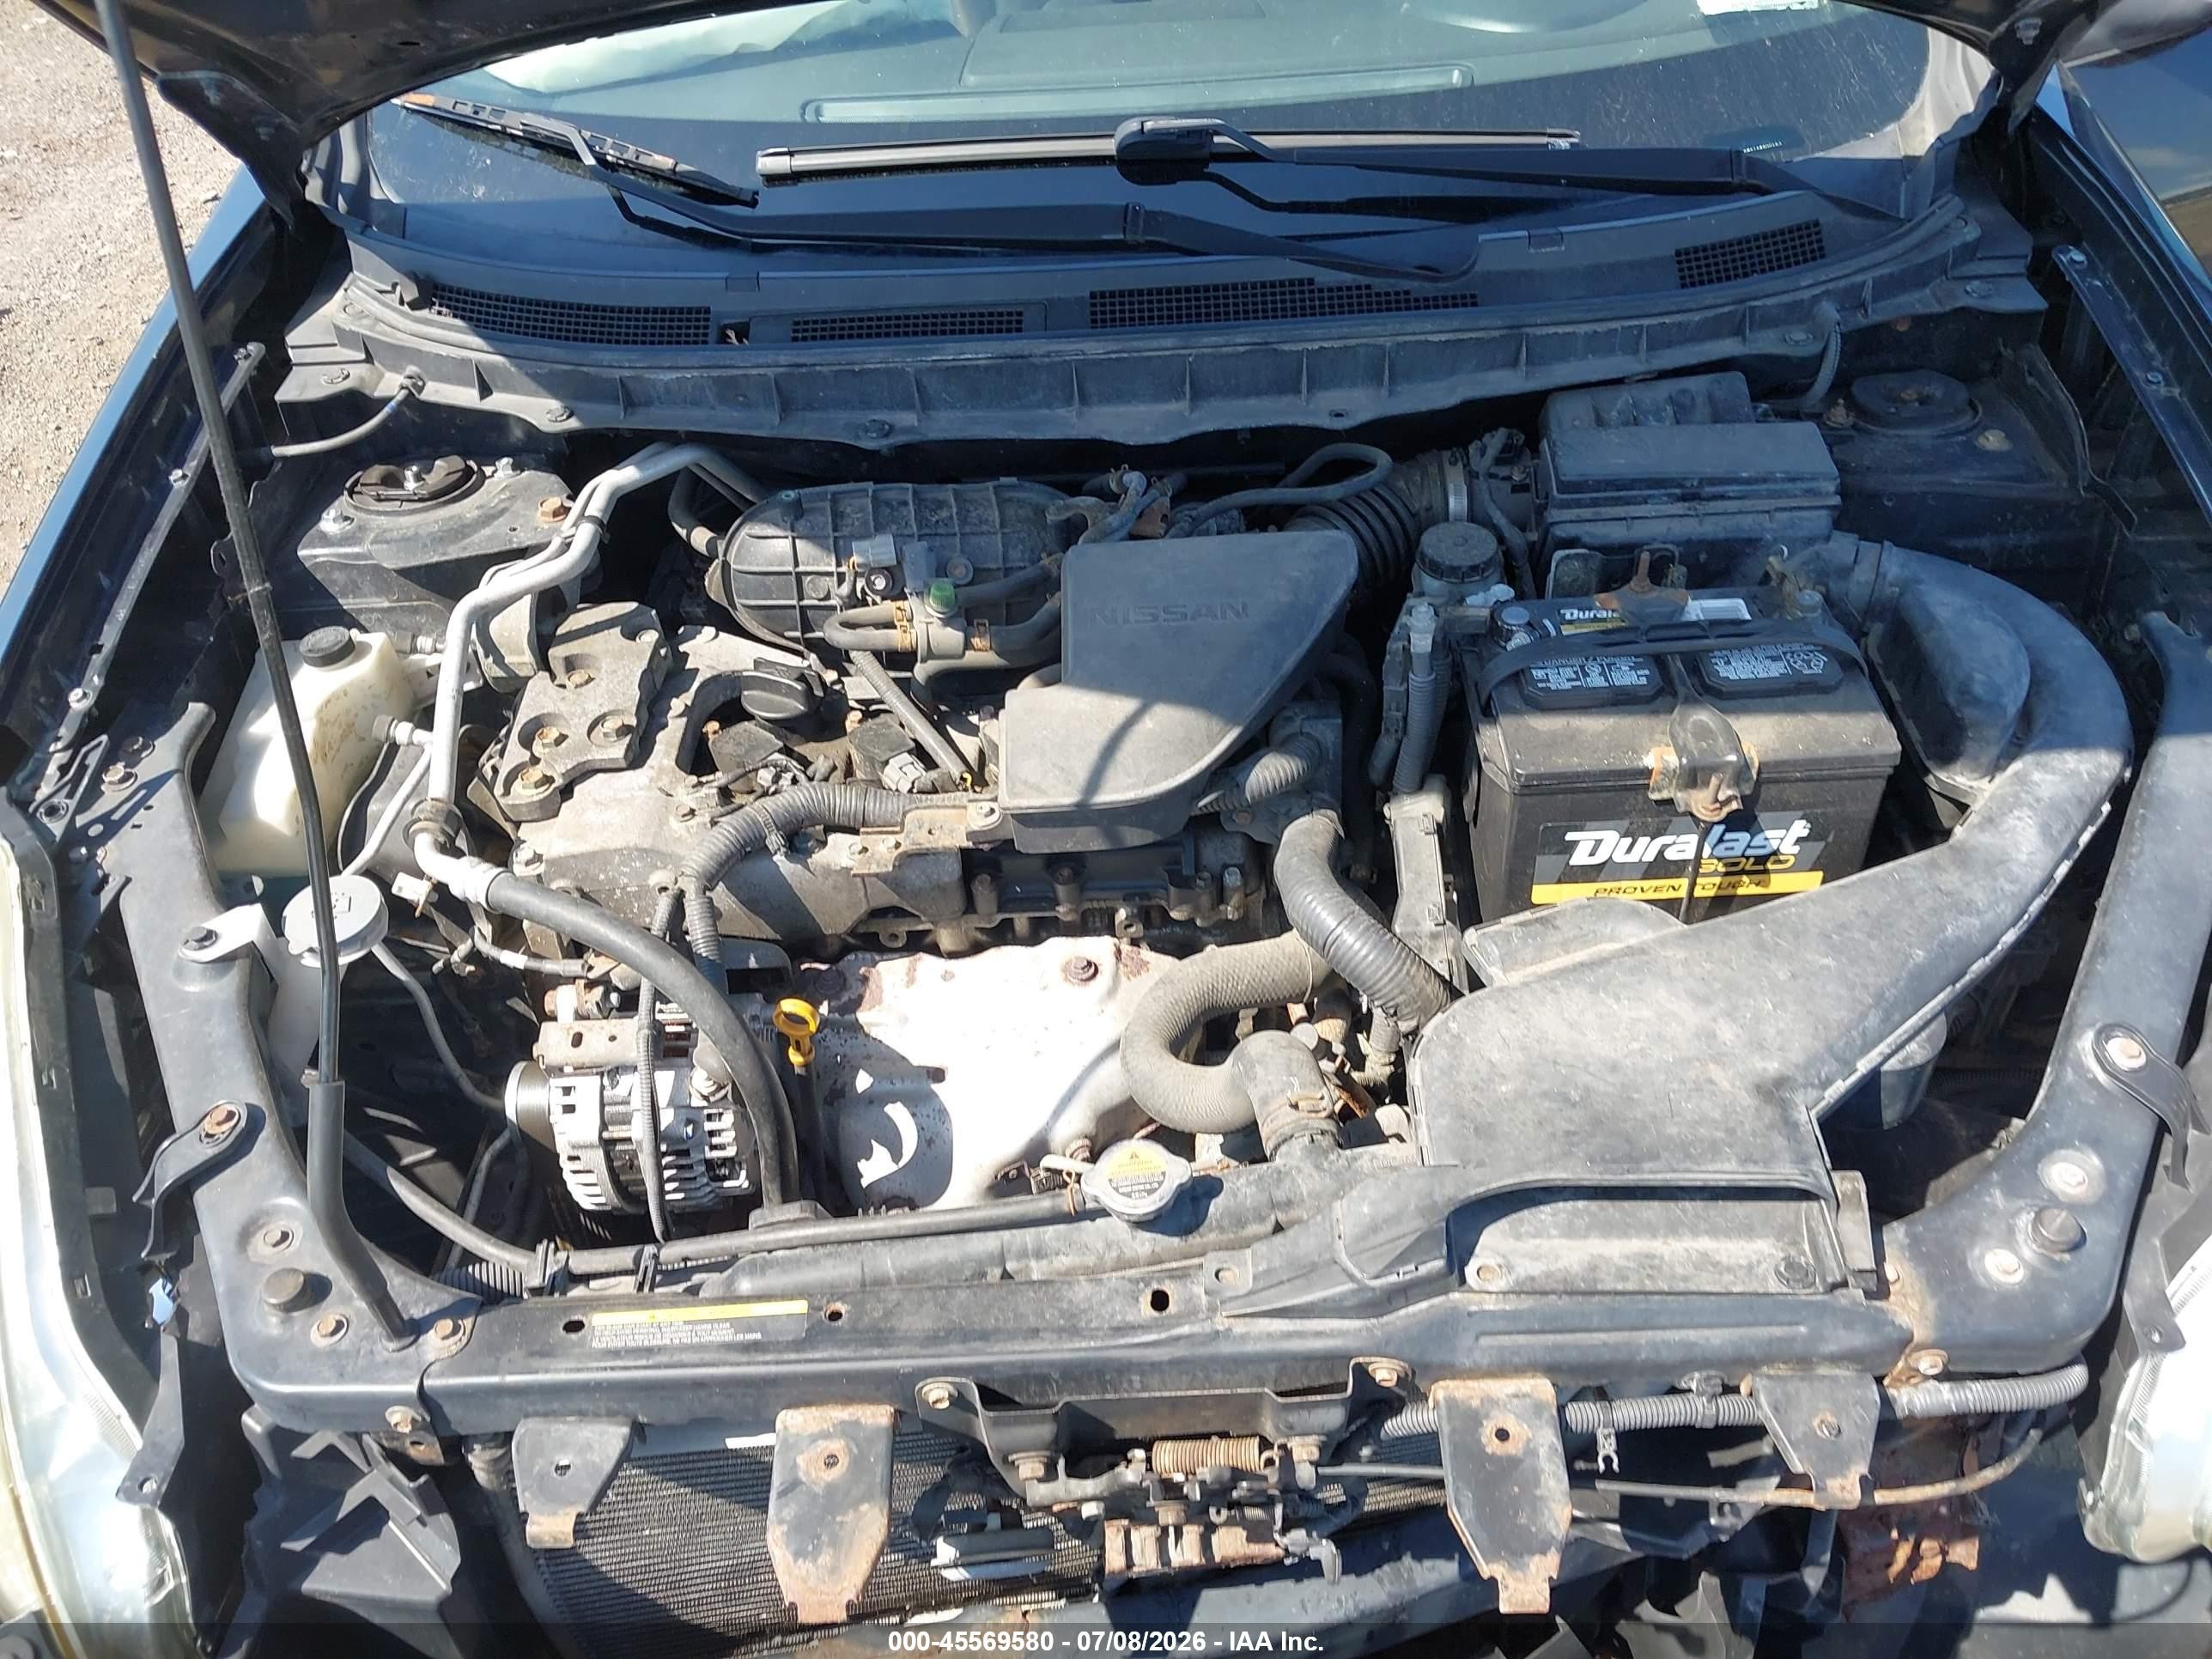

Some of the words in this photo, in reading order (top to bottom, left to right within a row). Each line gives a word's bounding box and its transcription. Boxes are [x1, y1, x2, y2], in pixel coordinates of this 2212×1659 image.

[1087, 601, 1250, 626] NISSAN
[1564, 818, 1812, 866] Duralast
[1593, 884, 1683, 898] PROVEN
